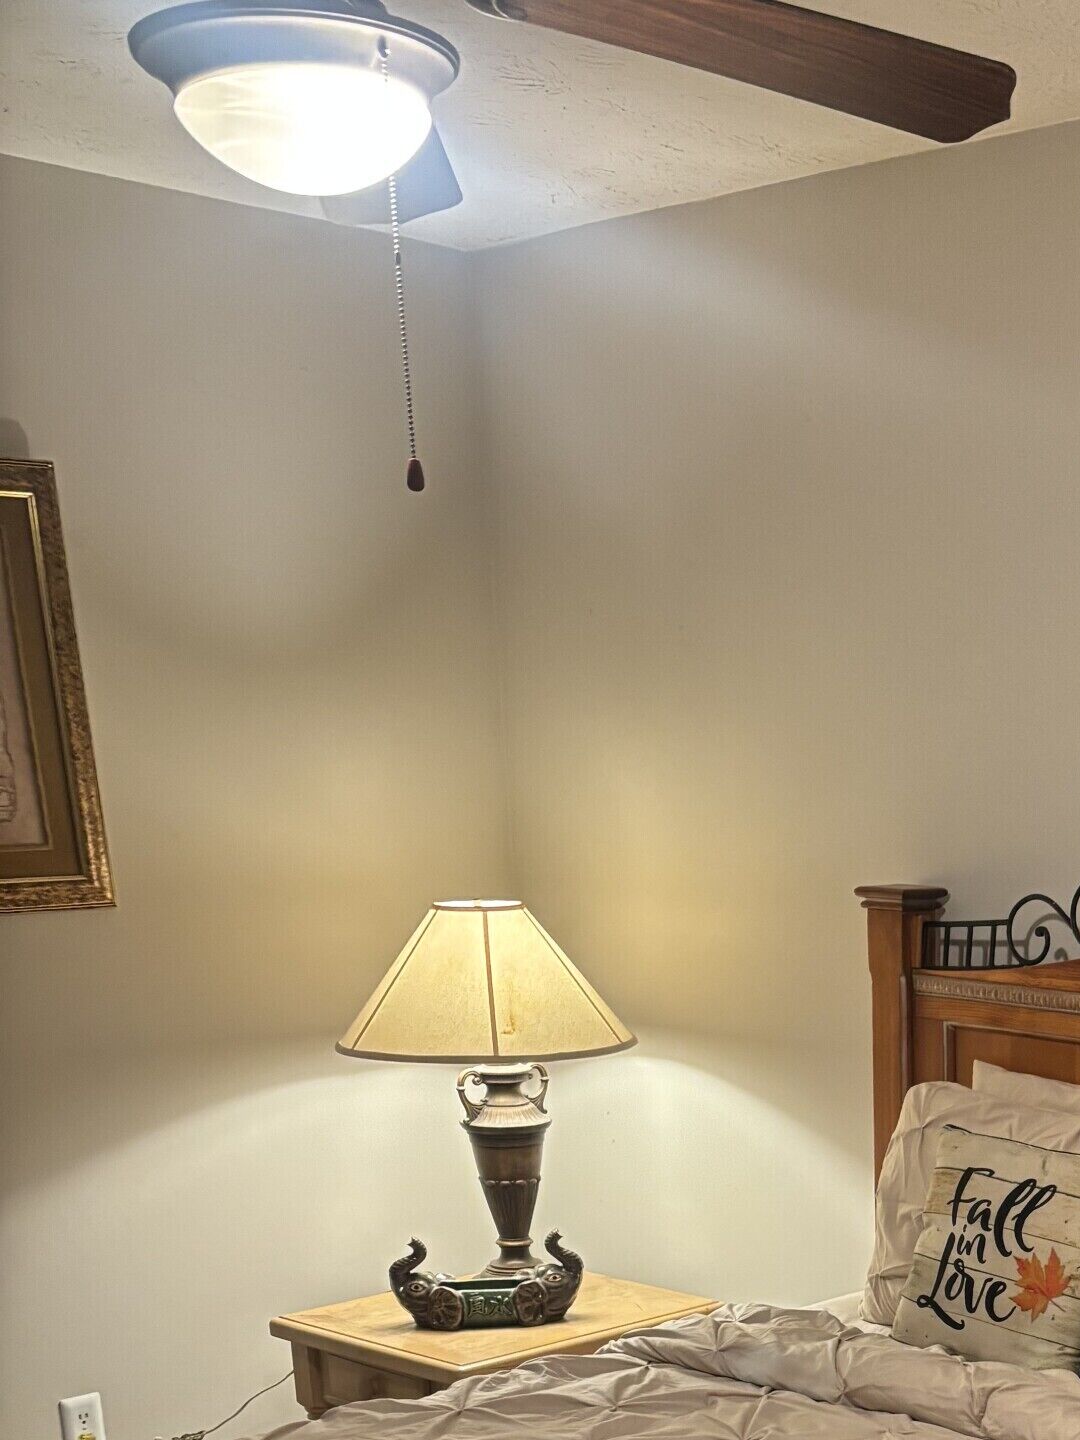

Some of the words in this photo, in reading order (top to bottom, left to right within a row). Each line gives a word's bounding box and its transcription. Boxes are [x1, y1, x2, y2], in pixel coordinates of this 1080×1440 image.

[947, 1167, 1057, 1257] Fall
[957, 1225, 987, 1264] in
[917, 1234, 1016, 1330] Love
